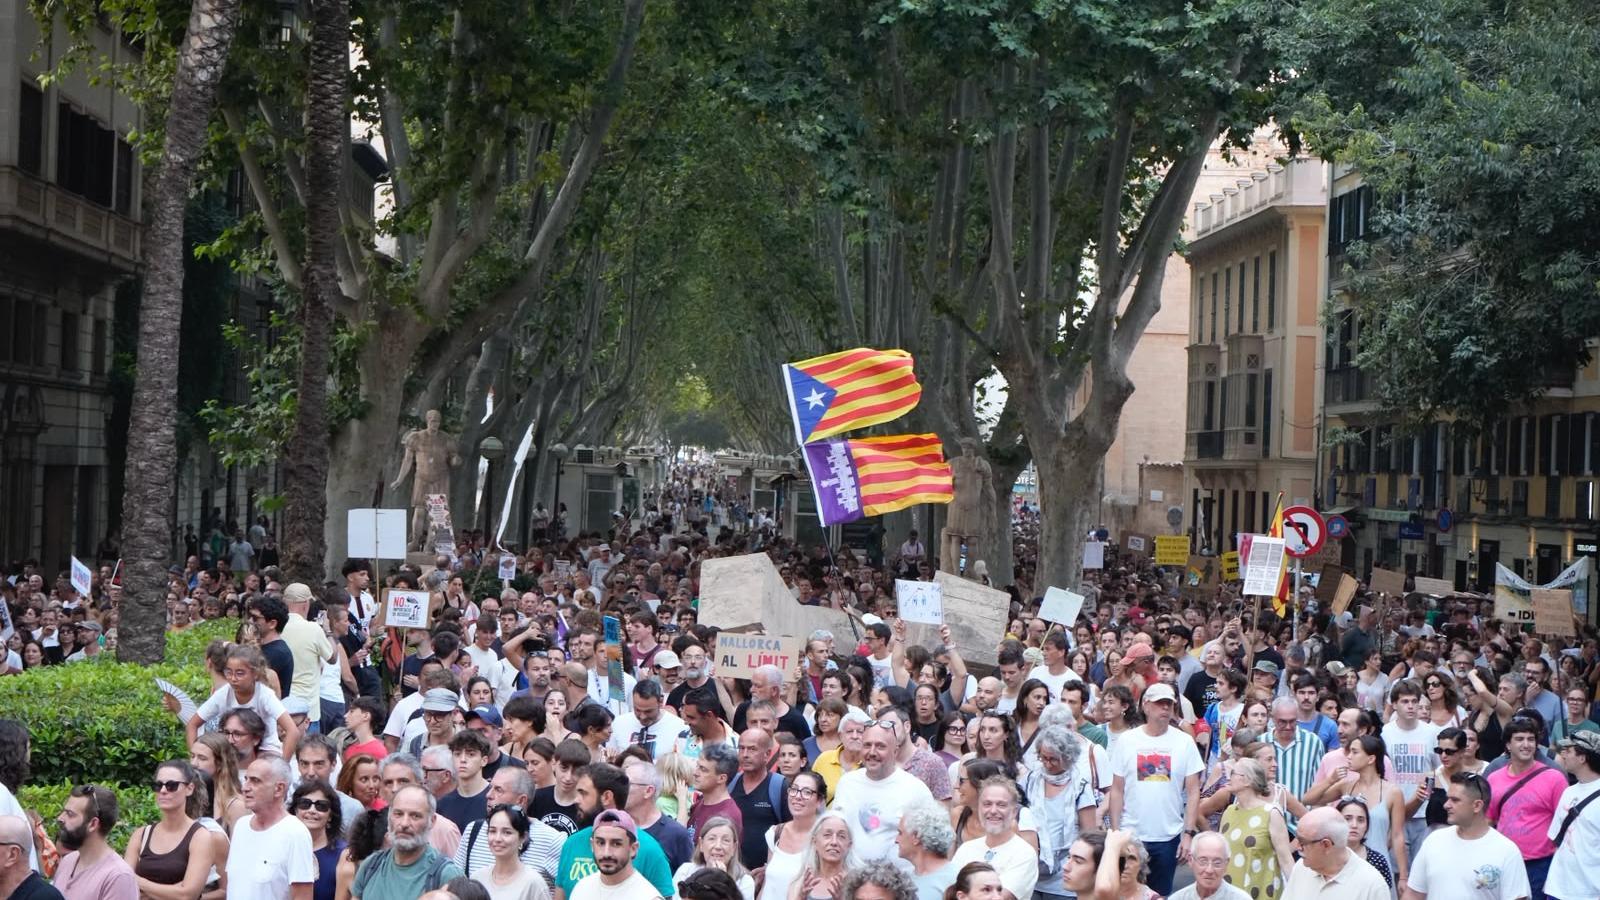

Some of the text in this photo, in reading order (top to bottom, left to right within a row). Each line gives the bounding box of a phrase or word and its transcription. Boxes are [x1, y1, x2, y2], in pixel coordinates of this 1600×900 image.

[393, 596, 405, 607] NO
[1518, 610, 1536, 620] IDI
[720, 636, 780, 651] MALLORCA
[721, 655, 738, 667] AL
[1394, 744, 1408, 755] RED
[1395, 755, 1425, 773] CHILI
